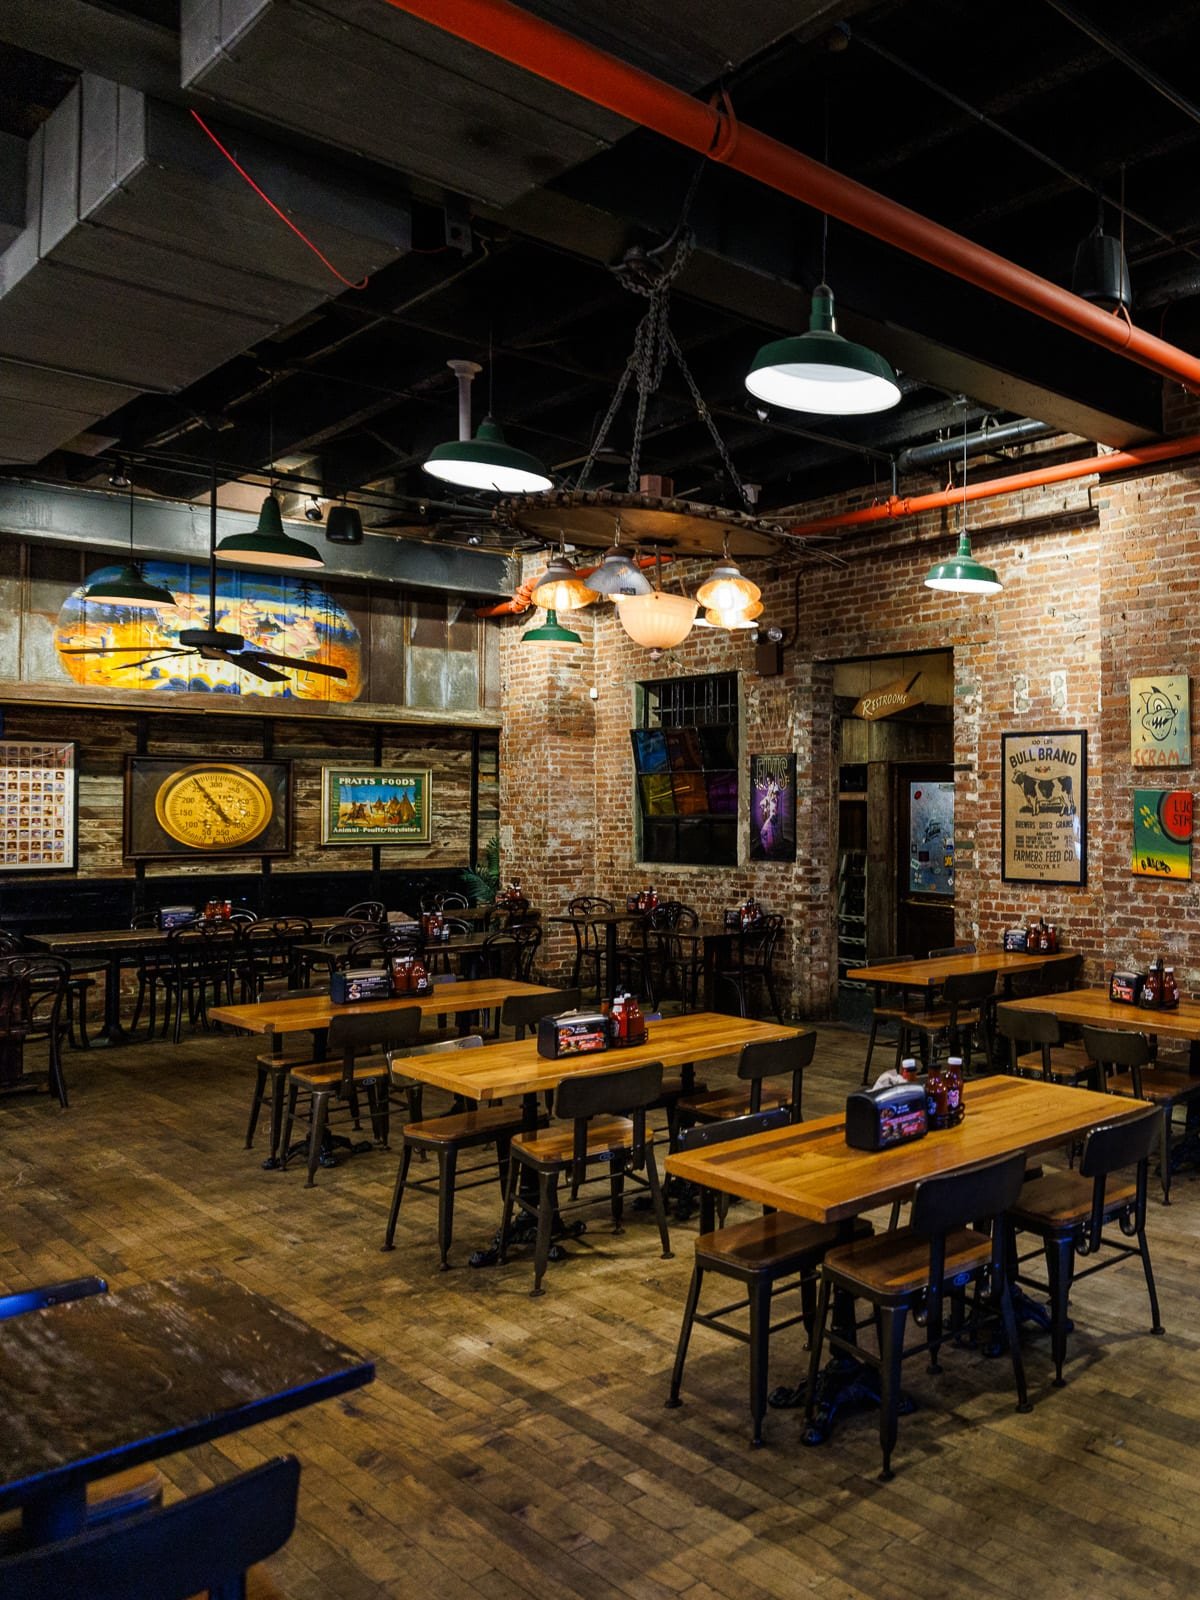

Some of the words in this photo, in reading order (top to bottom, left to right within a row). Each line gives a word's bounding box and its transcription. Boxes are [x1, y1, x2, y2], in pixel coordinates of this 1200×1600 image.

[862, 694, 907, 717] RESTROOMS
[1009, 749, 1036, 769] BULL
[1038, 747, 1077, 766] BRAND
[339, 777, 376, 785] PRATTS
[381, 778, 416, 786] FOODS
[1014, 849, 1043, 862] FARMERS
[1045, 851, 1061, 862] FEED
